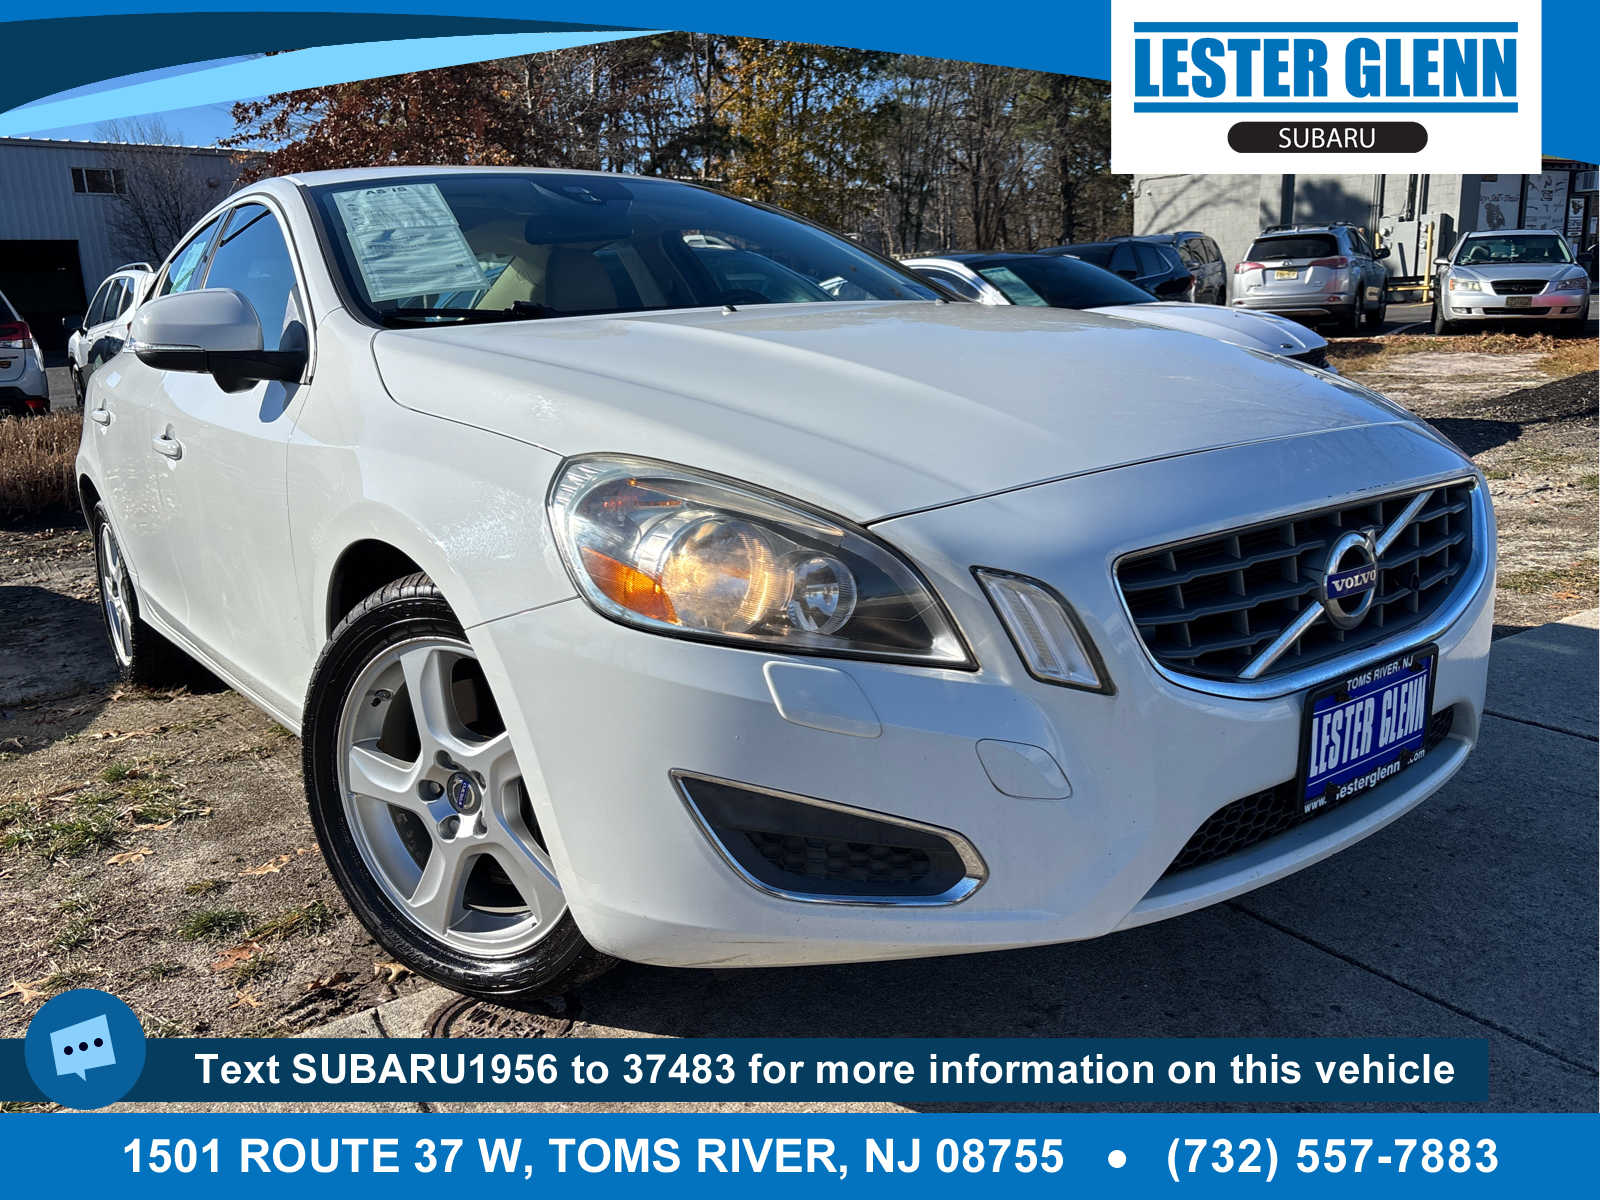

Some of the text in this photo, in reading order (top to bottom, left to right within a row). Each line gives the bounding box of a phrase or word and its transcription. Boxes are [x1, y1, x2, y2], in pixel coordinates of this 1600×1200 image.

[366, 188, 387, 196] AS
[1331, 569, 1377, 592] VOLVO
[1346, 672, 1372, 691] TOMS
[1402, 655, 1414, 670] NJ
[1308, 674, 1428, 779] LESTER GLENN
